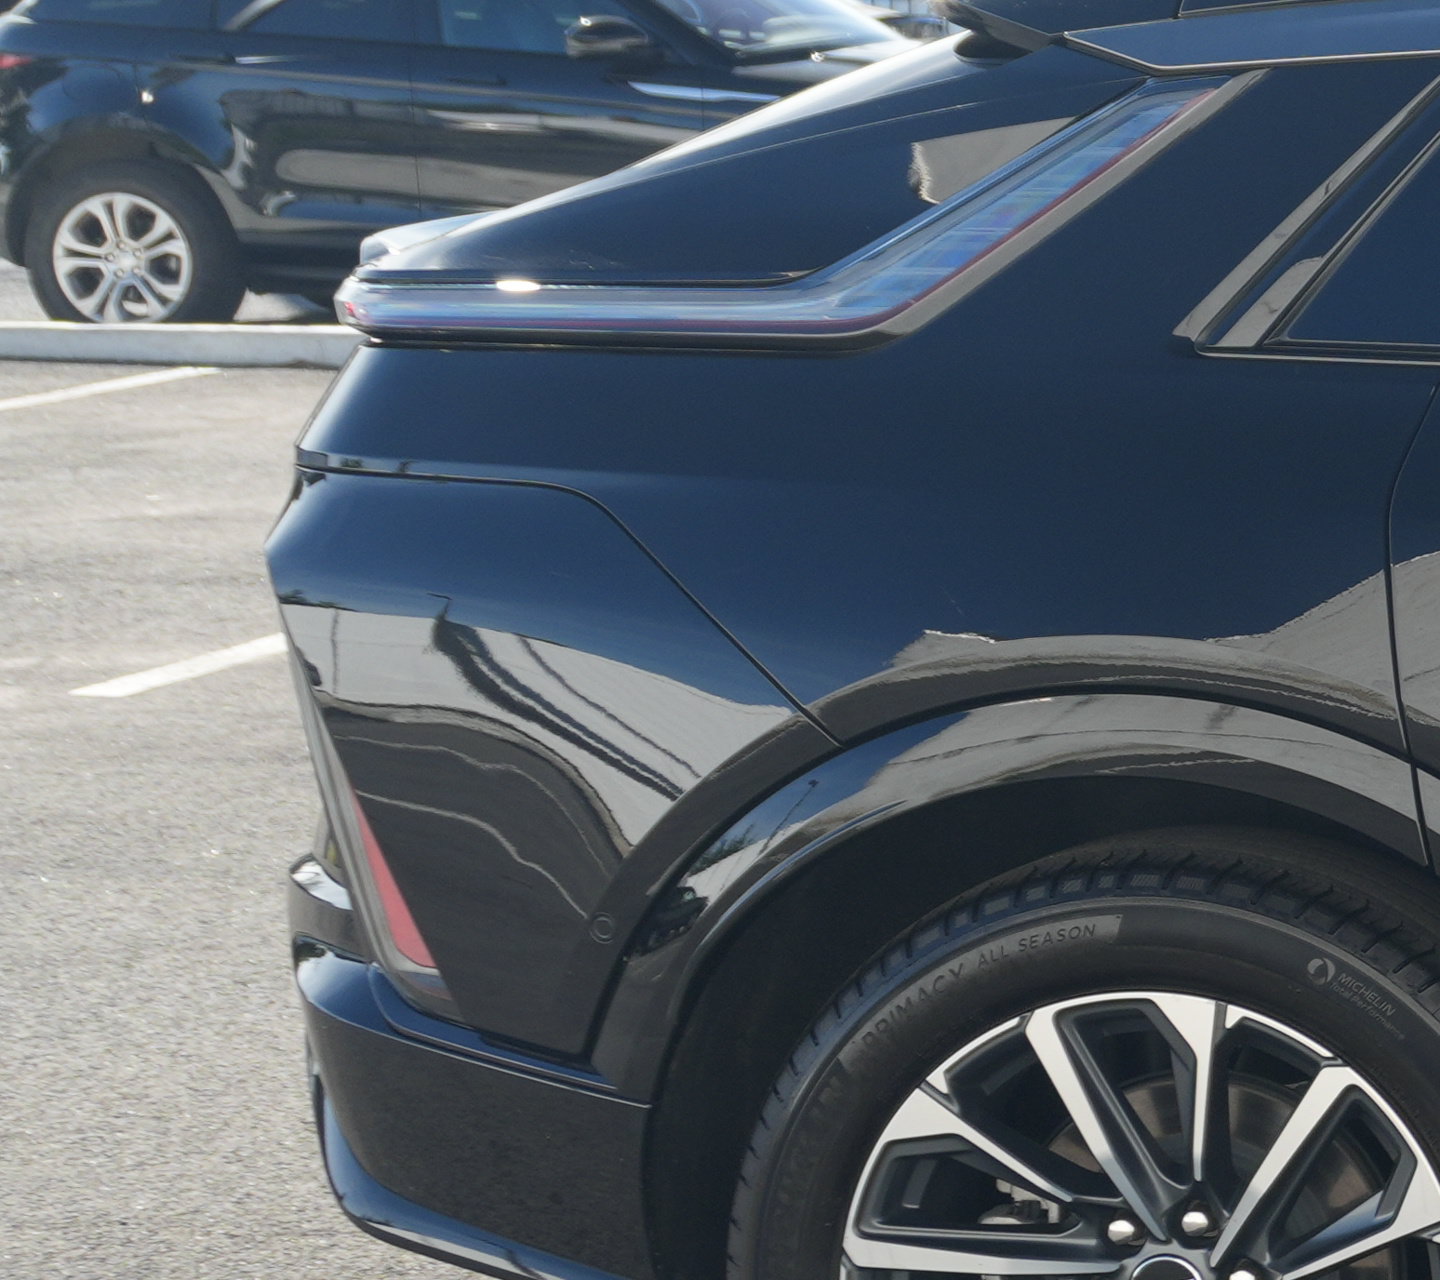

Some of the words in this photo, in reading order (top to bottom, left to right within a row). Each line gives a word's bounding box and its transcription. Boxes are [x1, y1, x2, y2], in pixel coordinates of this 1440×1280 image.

[861, 963, 966, 1048] PRIMACY
[977, 944, 1009, 969] ALL
[1018, 923, 1097, 952] SEASON
[1338, 973, 1396, 1017] MICHELIN
